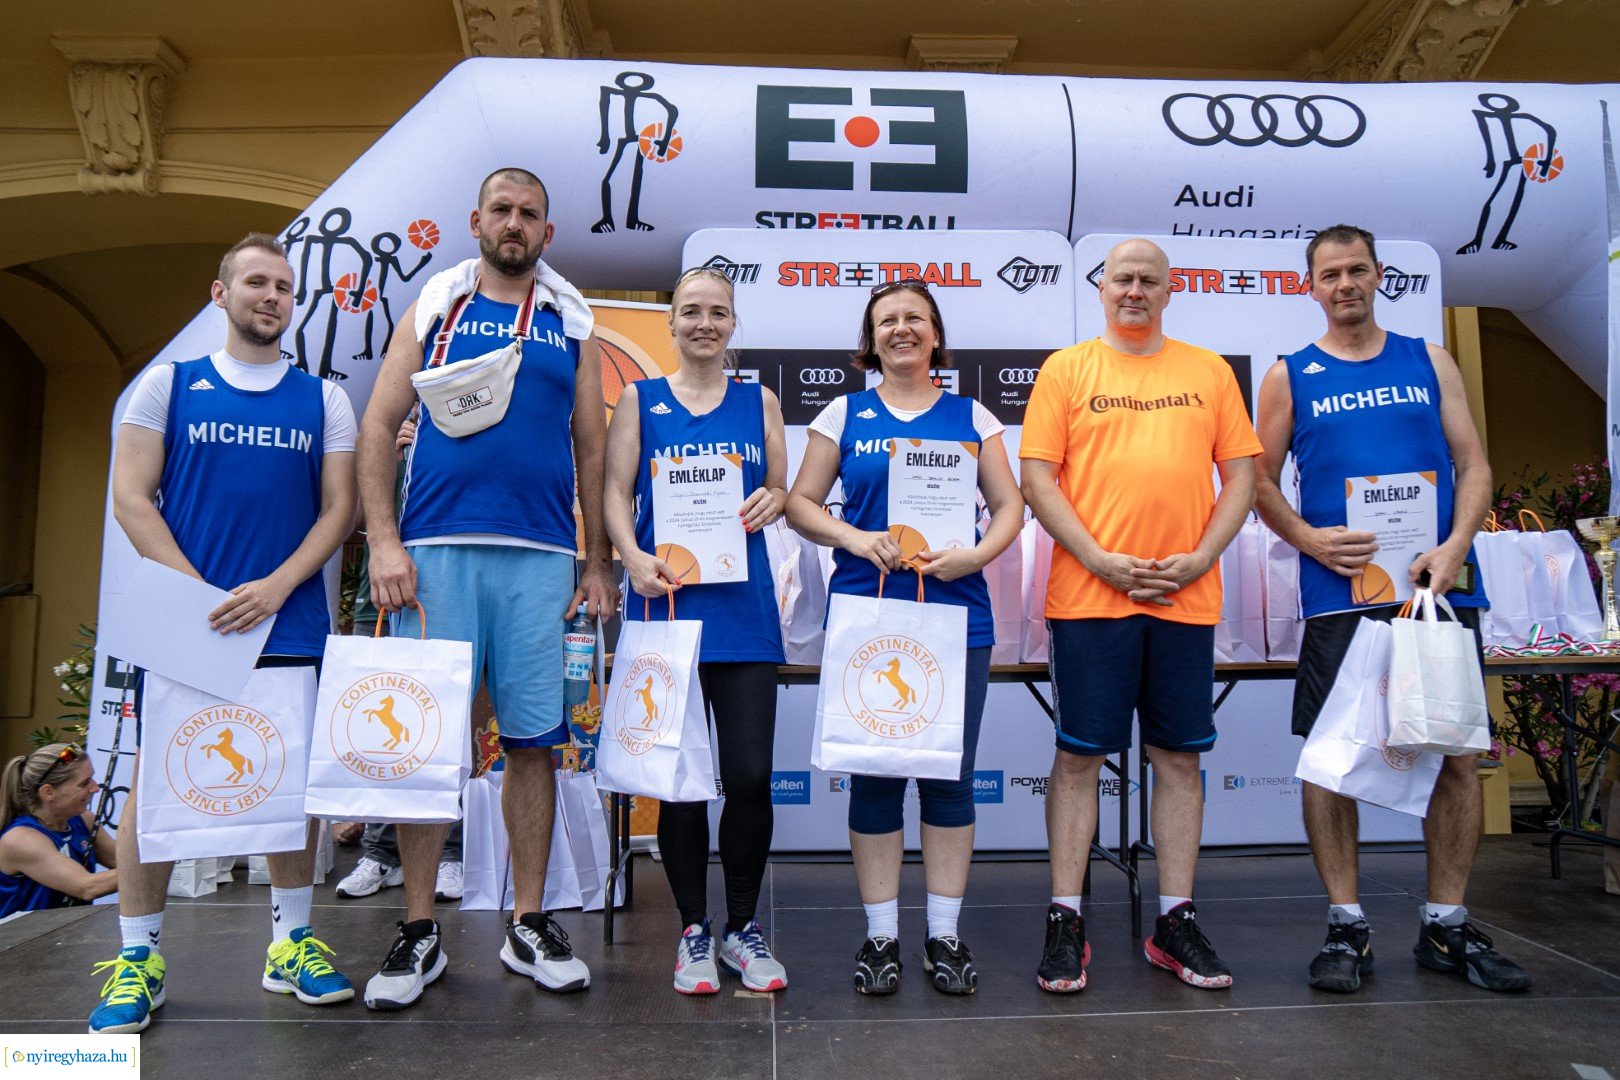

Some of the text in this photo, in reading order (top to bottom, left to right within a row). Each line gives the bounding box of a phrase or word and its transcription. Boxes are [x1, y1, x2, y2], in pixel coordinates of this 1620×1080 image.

[1174, 184, 1254, 207] Audi
[777, 262, 982, 287] STREETBALL
[1011, 264, 1063, 286] TOTI
[1383, 274, 1431, 294] TOTI
[454, 320, 568, 352] MICHLIN
[1090, 393, 1191, 413] Continental
[1312, 385, 1431, 418] MICHELIN
[188, 421, 313, 454] MICHELIN
[906, 450, 961, 468] EMLÉKLAP
[669, 466, 726, 485] EMLÉKLAP
[1364, 485, 1421, 503] EMLÉKLAP
[852, 638, 938, 678] CONTINENTAL
[624, 656, 674, 692] CONTINENTAL
[341, 676, 436, 716] CONTINENTAL
[176, 708, 277, 748] CONTINENTAL
[856, 710, 930, 737] SINCE 1871
[618, 727, 642, 753] SINCE
[342, 751, 423, 779] SINCE 1871
[972, 779, 998, 789] lten
[1250, 777, 1290, 787] EXTREME
[184, 784, 269, 813] SINCE 1871
